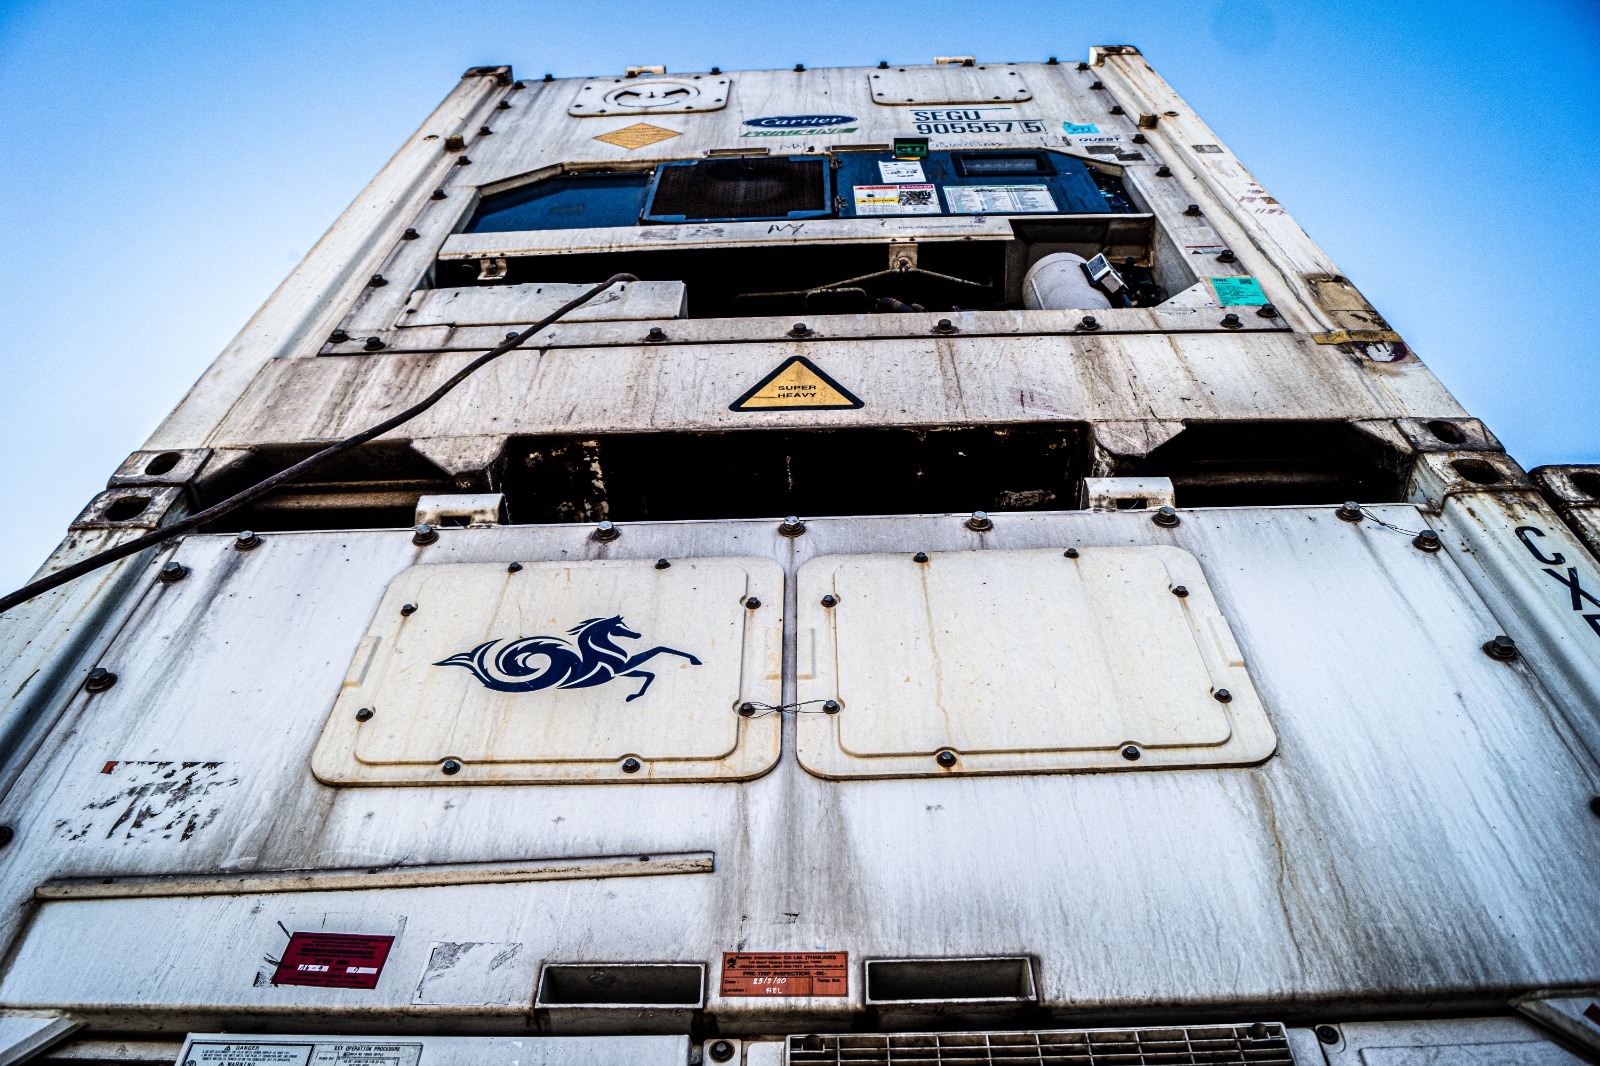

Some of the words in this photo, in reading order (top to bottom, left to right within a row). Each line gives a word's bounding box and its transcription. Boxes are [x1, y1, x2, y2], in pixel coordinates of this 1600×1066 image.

[913, 111, 982, 121] SEGU
[761, 117, 842, 126] Carrier
[744, 128, 850, 138] PRIMELINE
[916, 121, 1013, 135] 905557
[1024, 122, 1043, 133] 5
